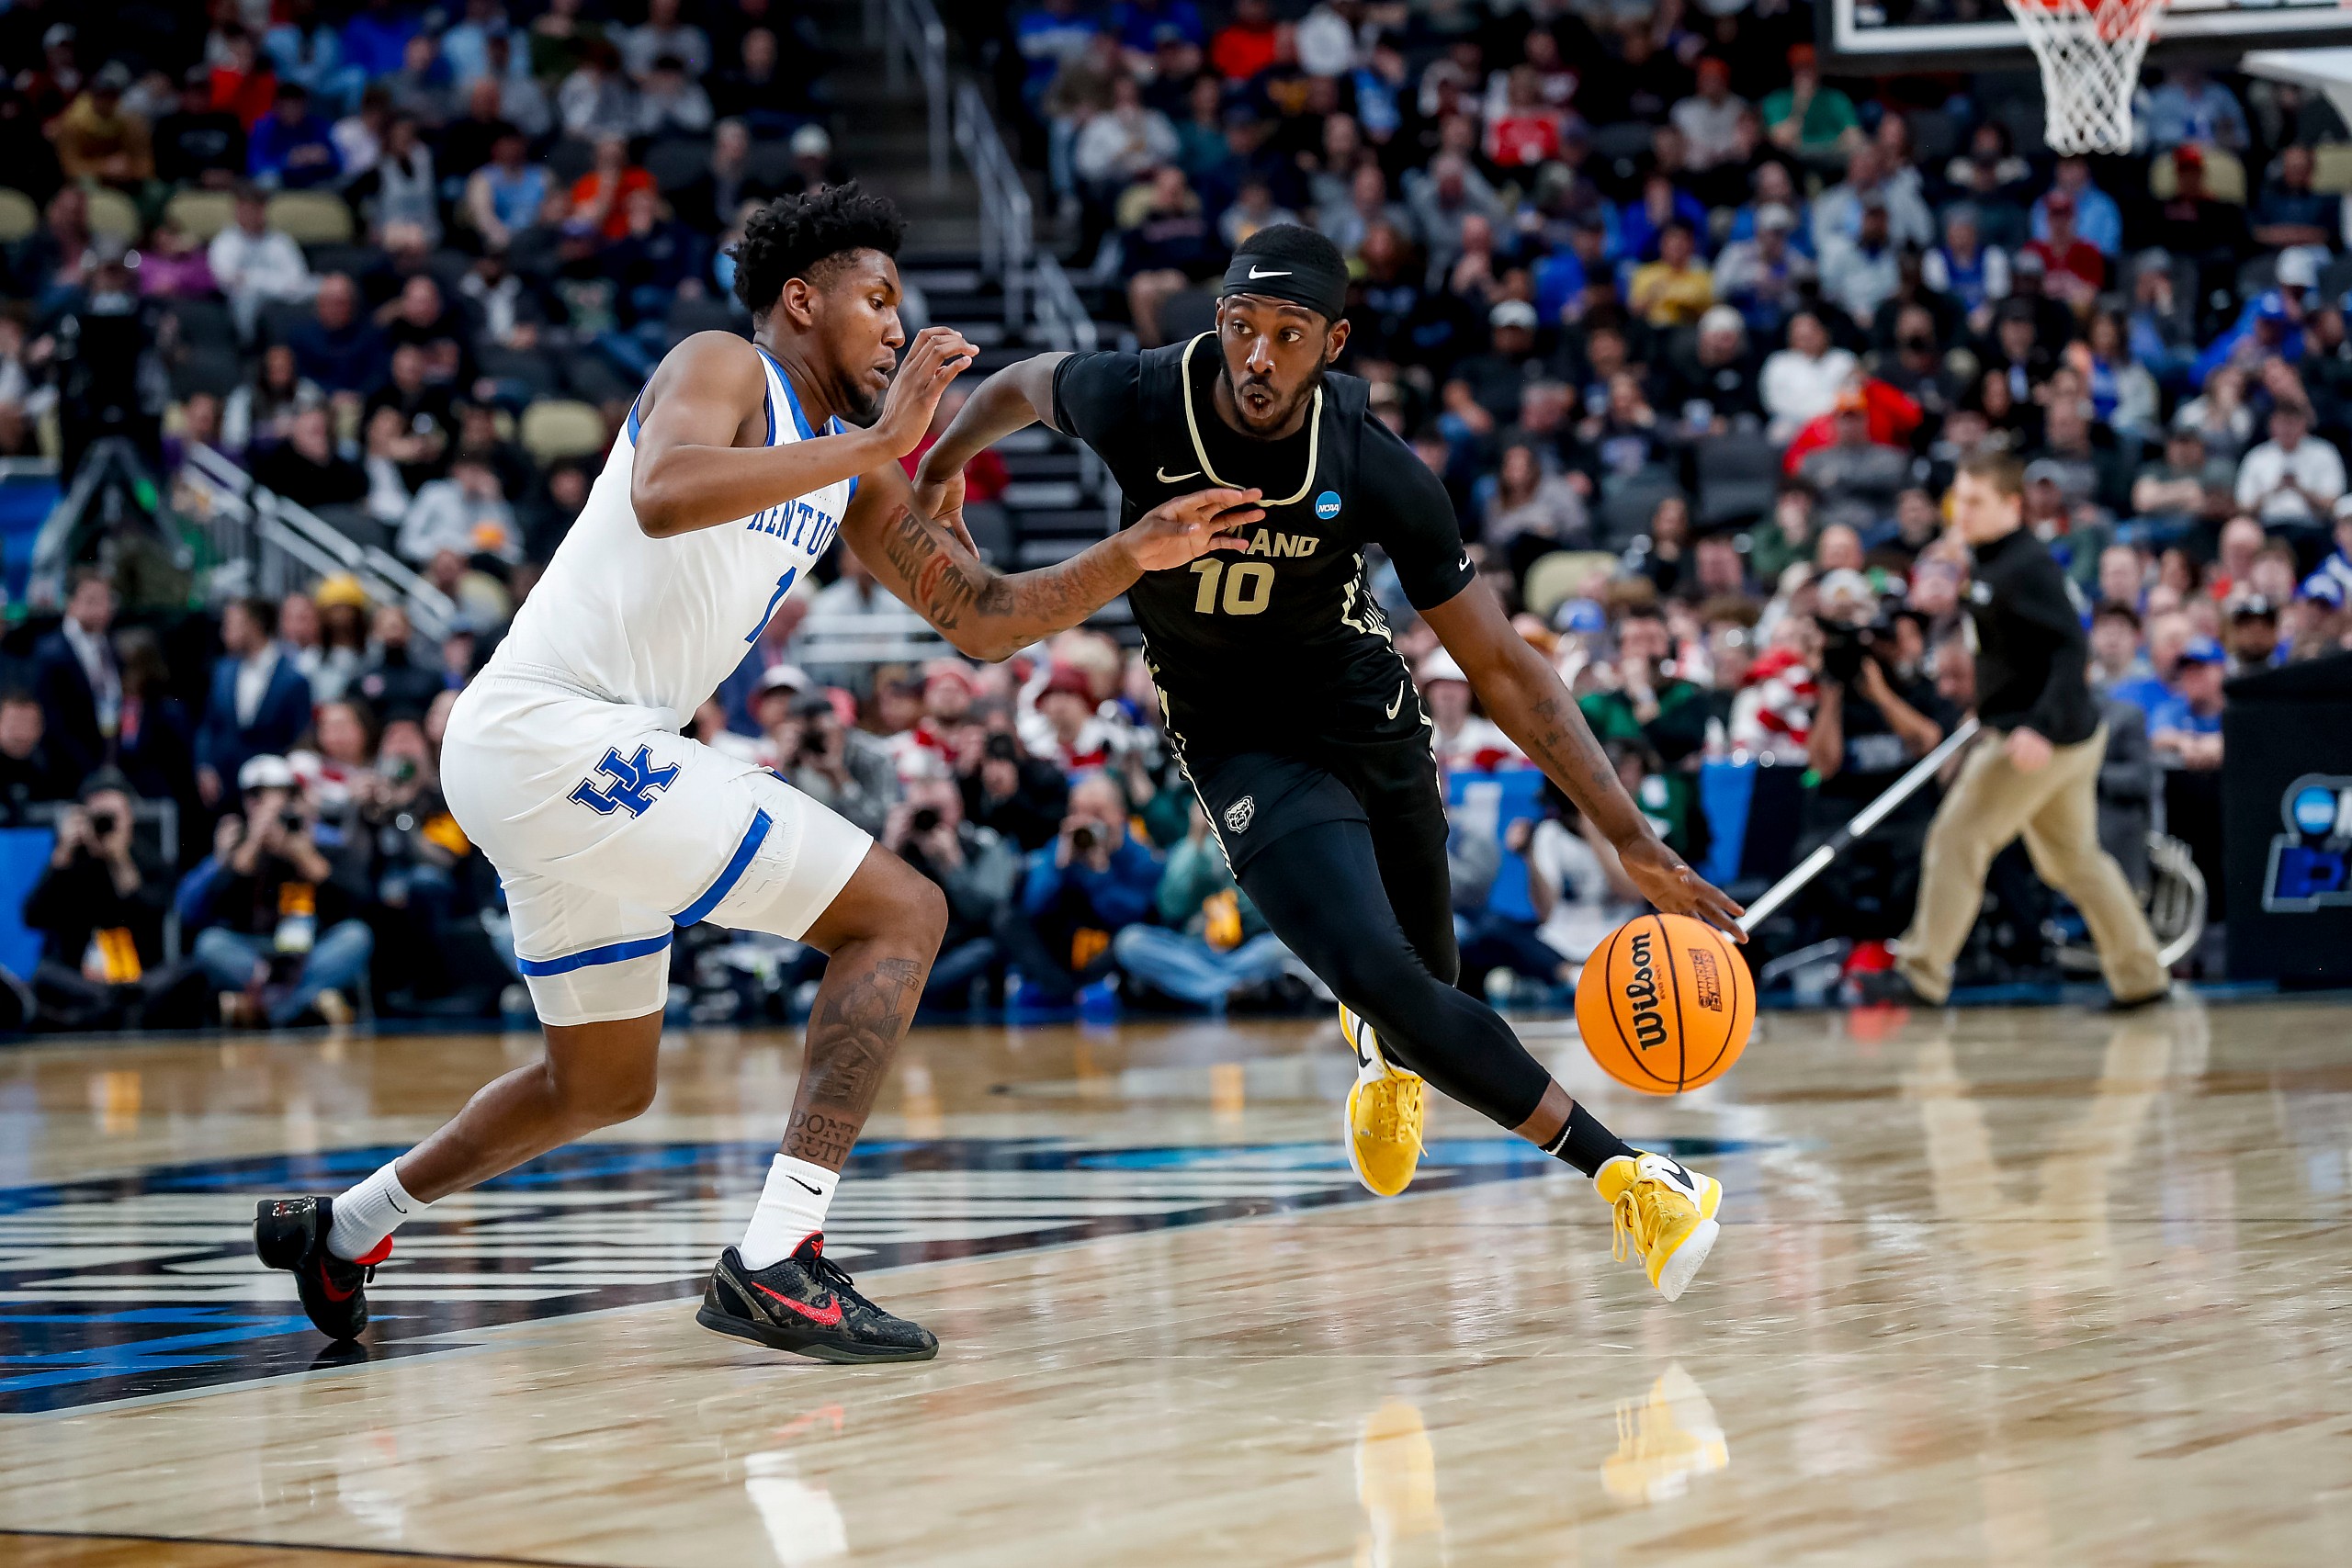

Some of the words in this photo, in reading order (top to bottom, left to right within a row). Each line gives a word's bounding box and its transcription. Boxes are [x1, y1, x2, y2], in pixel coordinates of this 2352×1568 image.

[1317, 503, 1340, 513] NCAA
[744, 566, 797, 644] 1
[1190, 558, 1275, 615] 10
[567, 743, 681, 819] UK
[1626, 930, 1668, 1052] Wilson
[787, 1132, 847, 1165] QUIT
